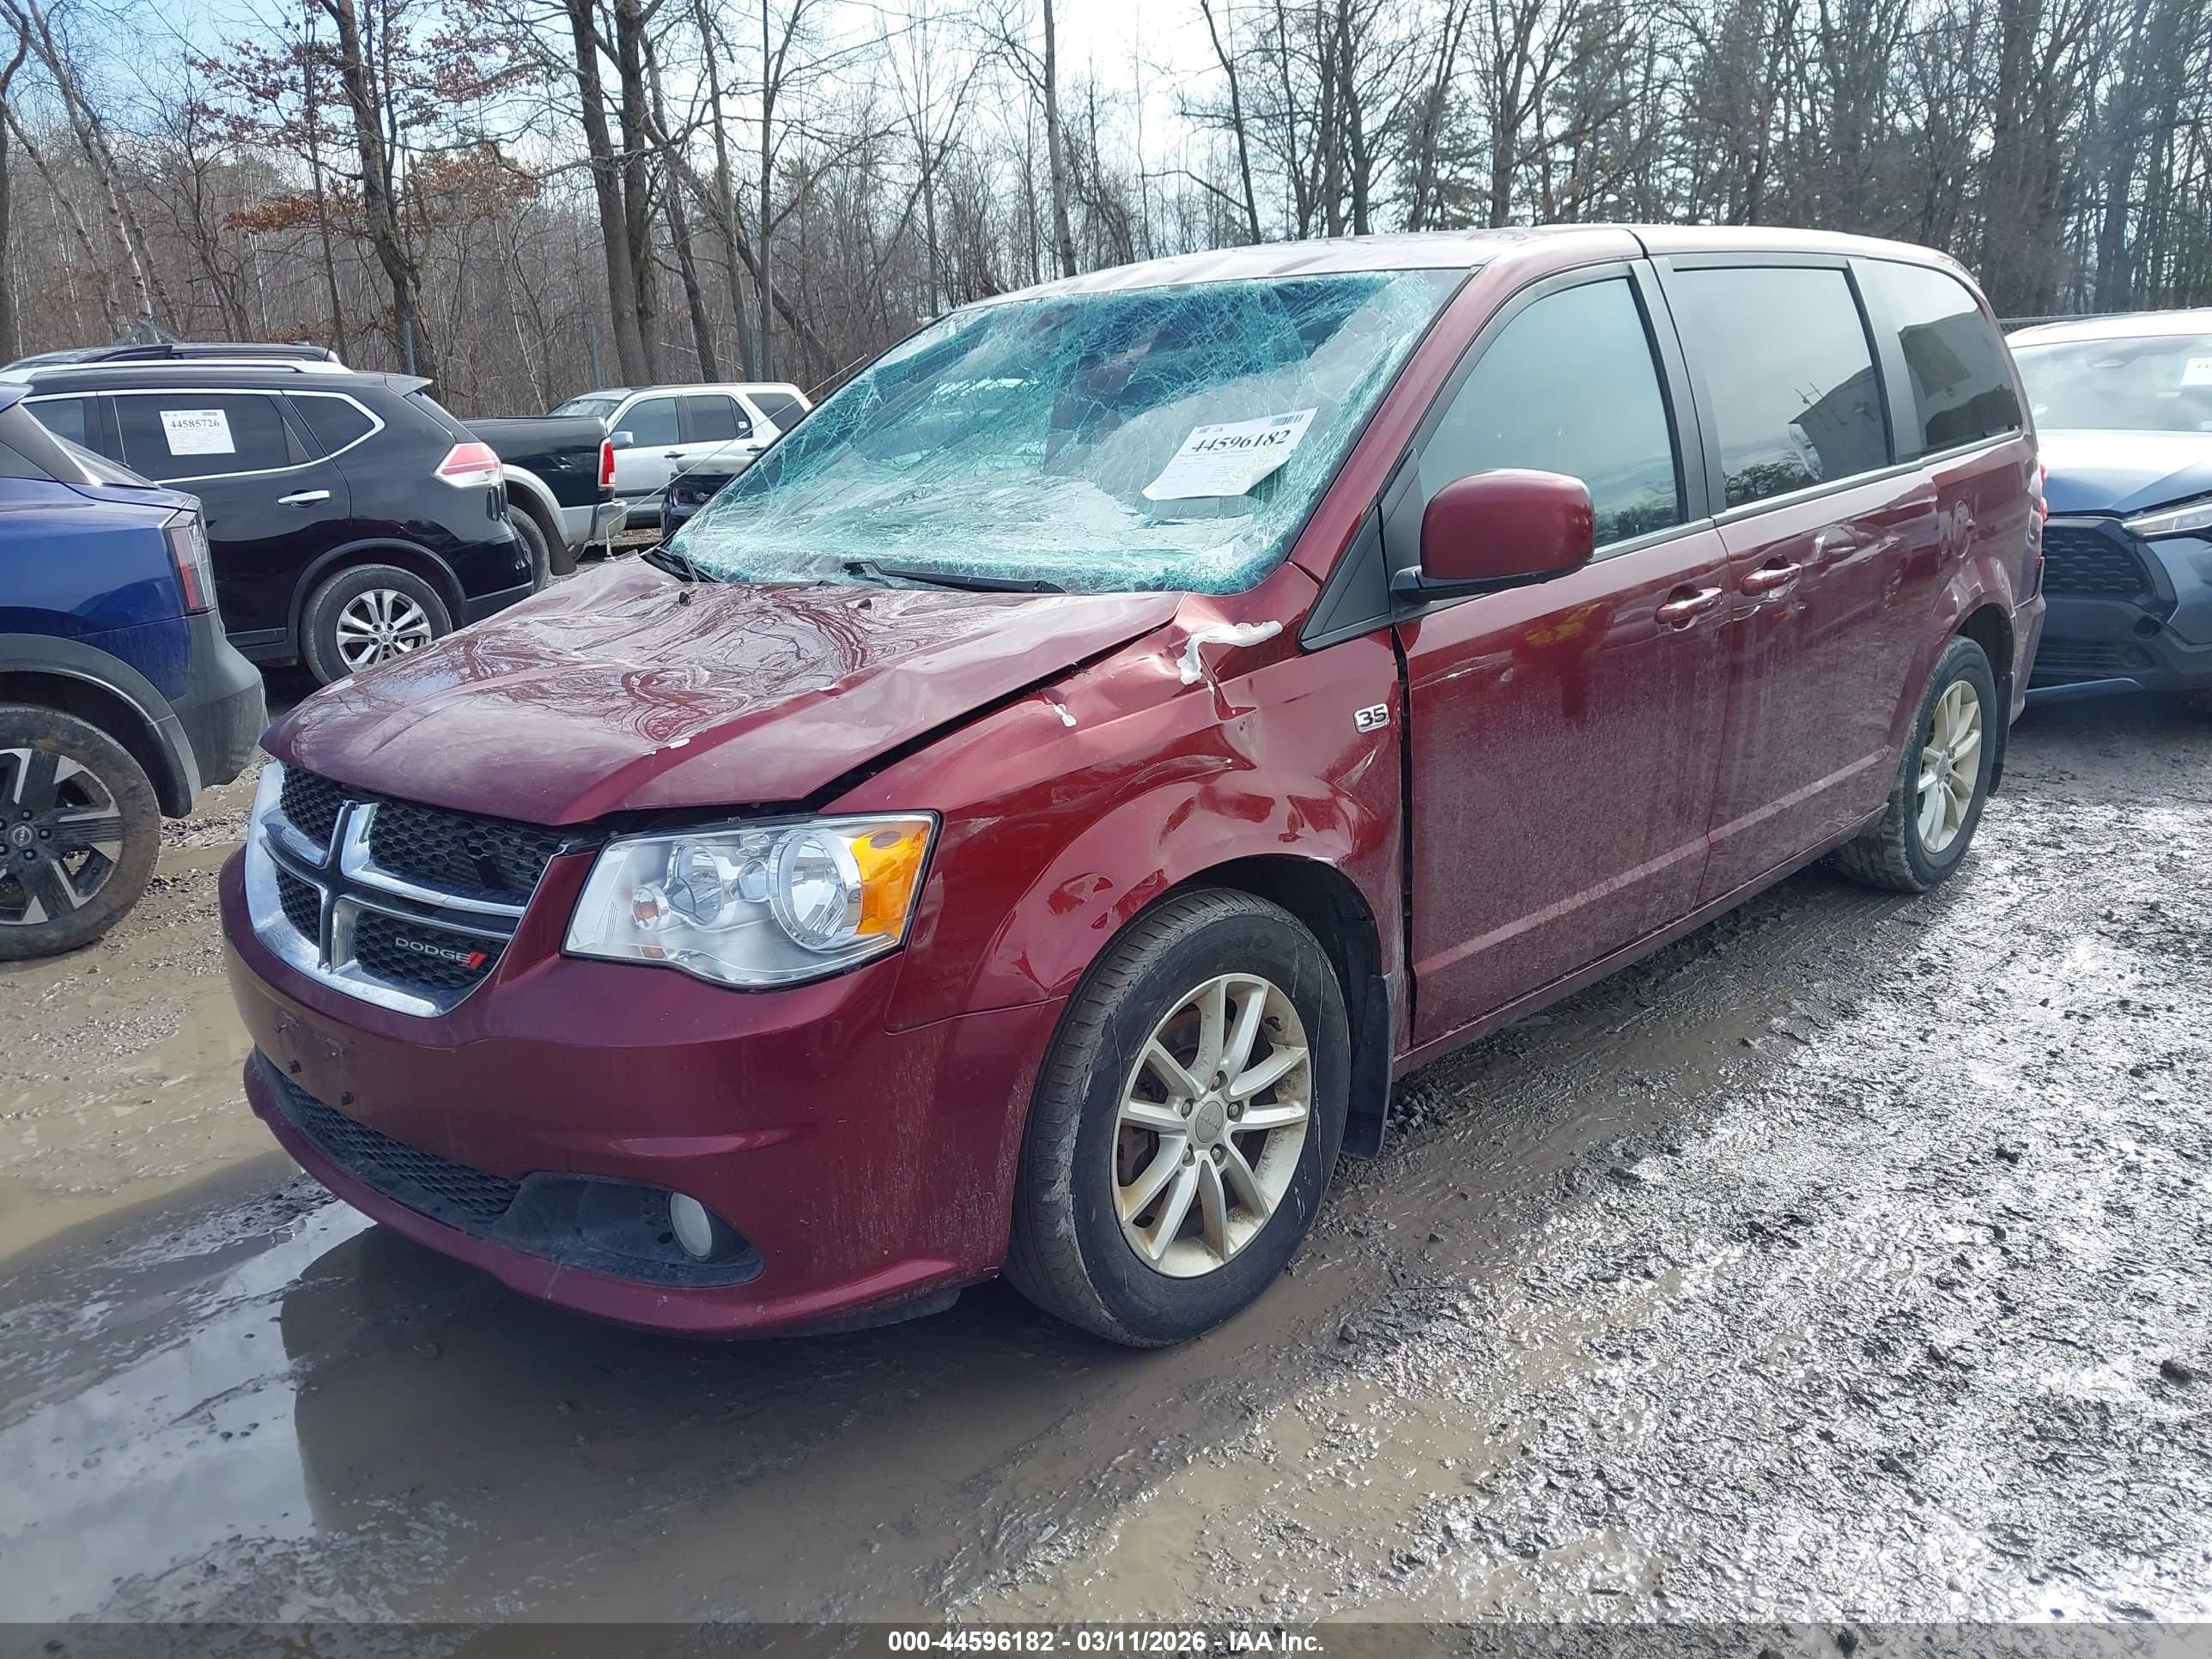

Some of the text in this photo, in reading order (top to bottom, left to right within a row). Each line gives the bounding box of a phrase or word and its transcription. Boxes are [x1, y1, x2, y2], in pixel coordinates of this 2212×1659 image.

[170, 418, 220, 428] 44585726
[1191, 429, 1291, 452] 44596182
[396, 937, 471, 963] DODGE
